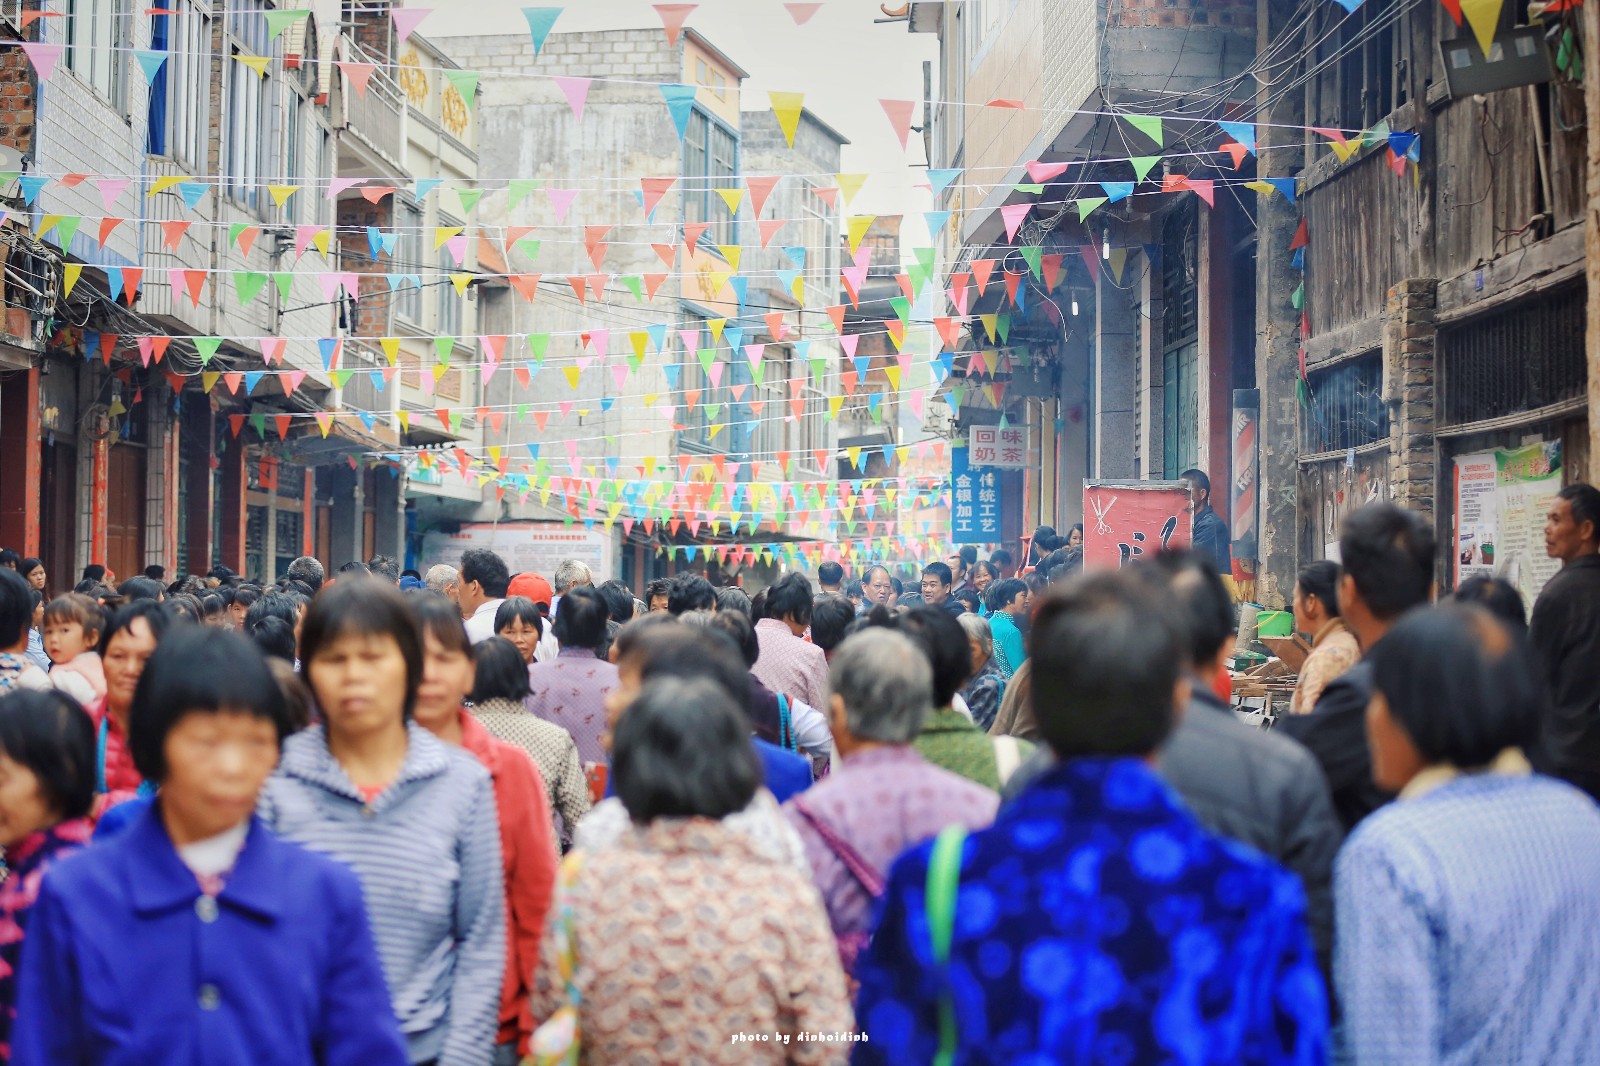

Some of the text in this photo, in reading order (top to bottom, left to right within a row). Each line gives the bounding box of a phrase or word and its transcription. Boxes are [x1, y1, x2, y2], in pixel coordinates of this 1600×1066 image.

[974, 447, 1022, 462] 奶茶
[976, 430, 1023, 445] 回味
[955, 474, 973, 532] 金银加工
[979, 473, 996, 532] 传统工艺
